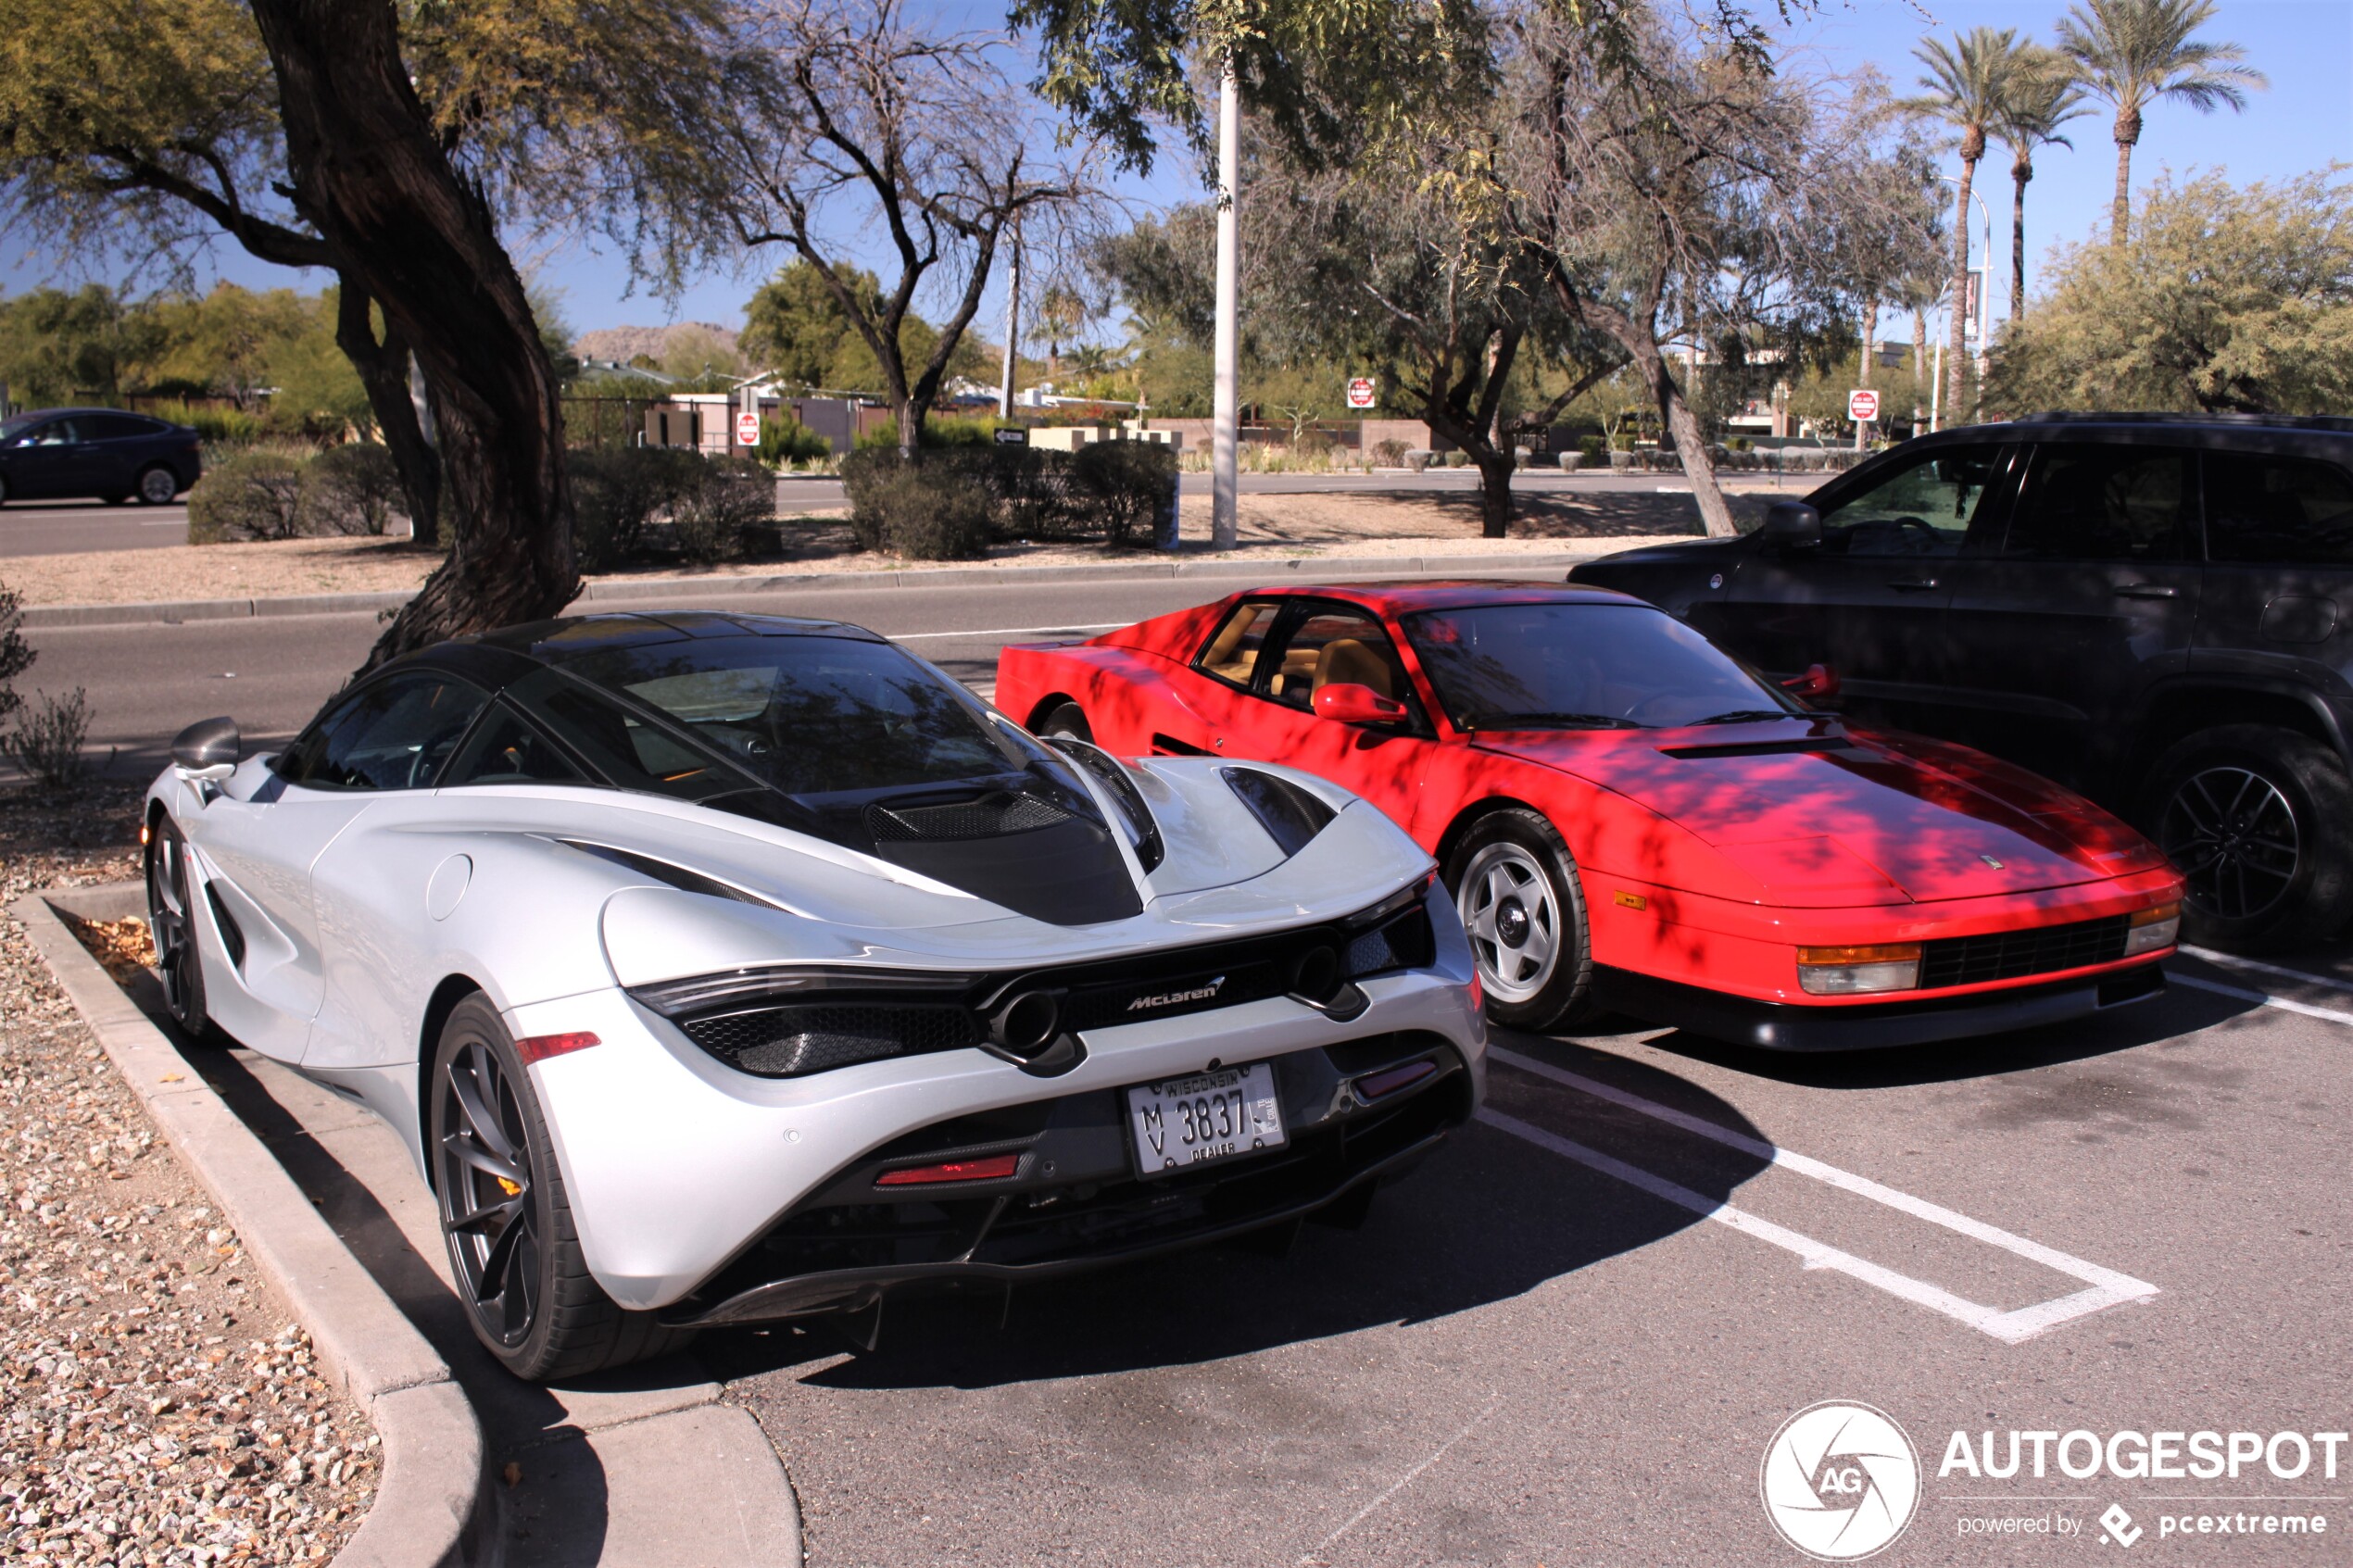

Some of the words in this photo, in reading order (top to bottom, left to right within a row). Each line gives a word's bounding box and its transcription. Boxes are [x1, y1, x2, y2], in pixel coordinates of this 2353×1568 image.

[1126, 986, 1215, 1010] McLaren
[1165, 1073, 1239, 1098] WISCONSIN
[1175, 1088, 1245, 1146] 3837
[1191, 1142, 1236, 1161] DEALER
